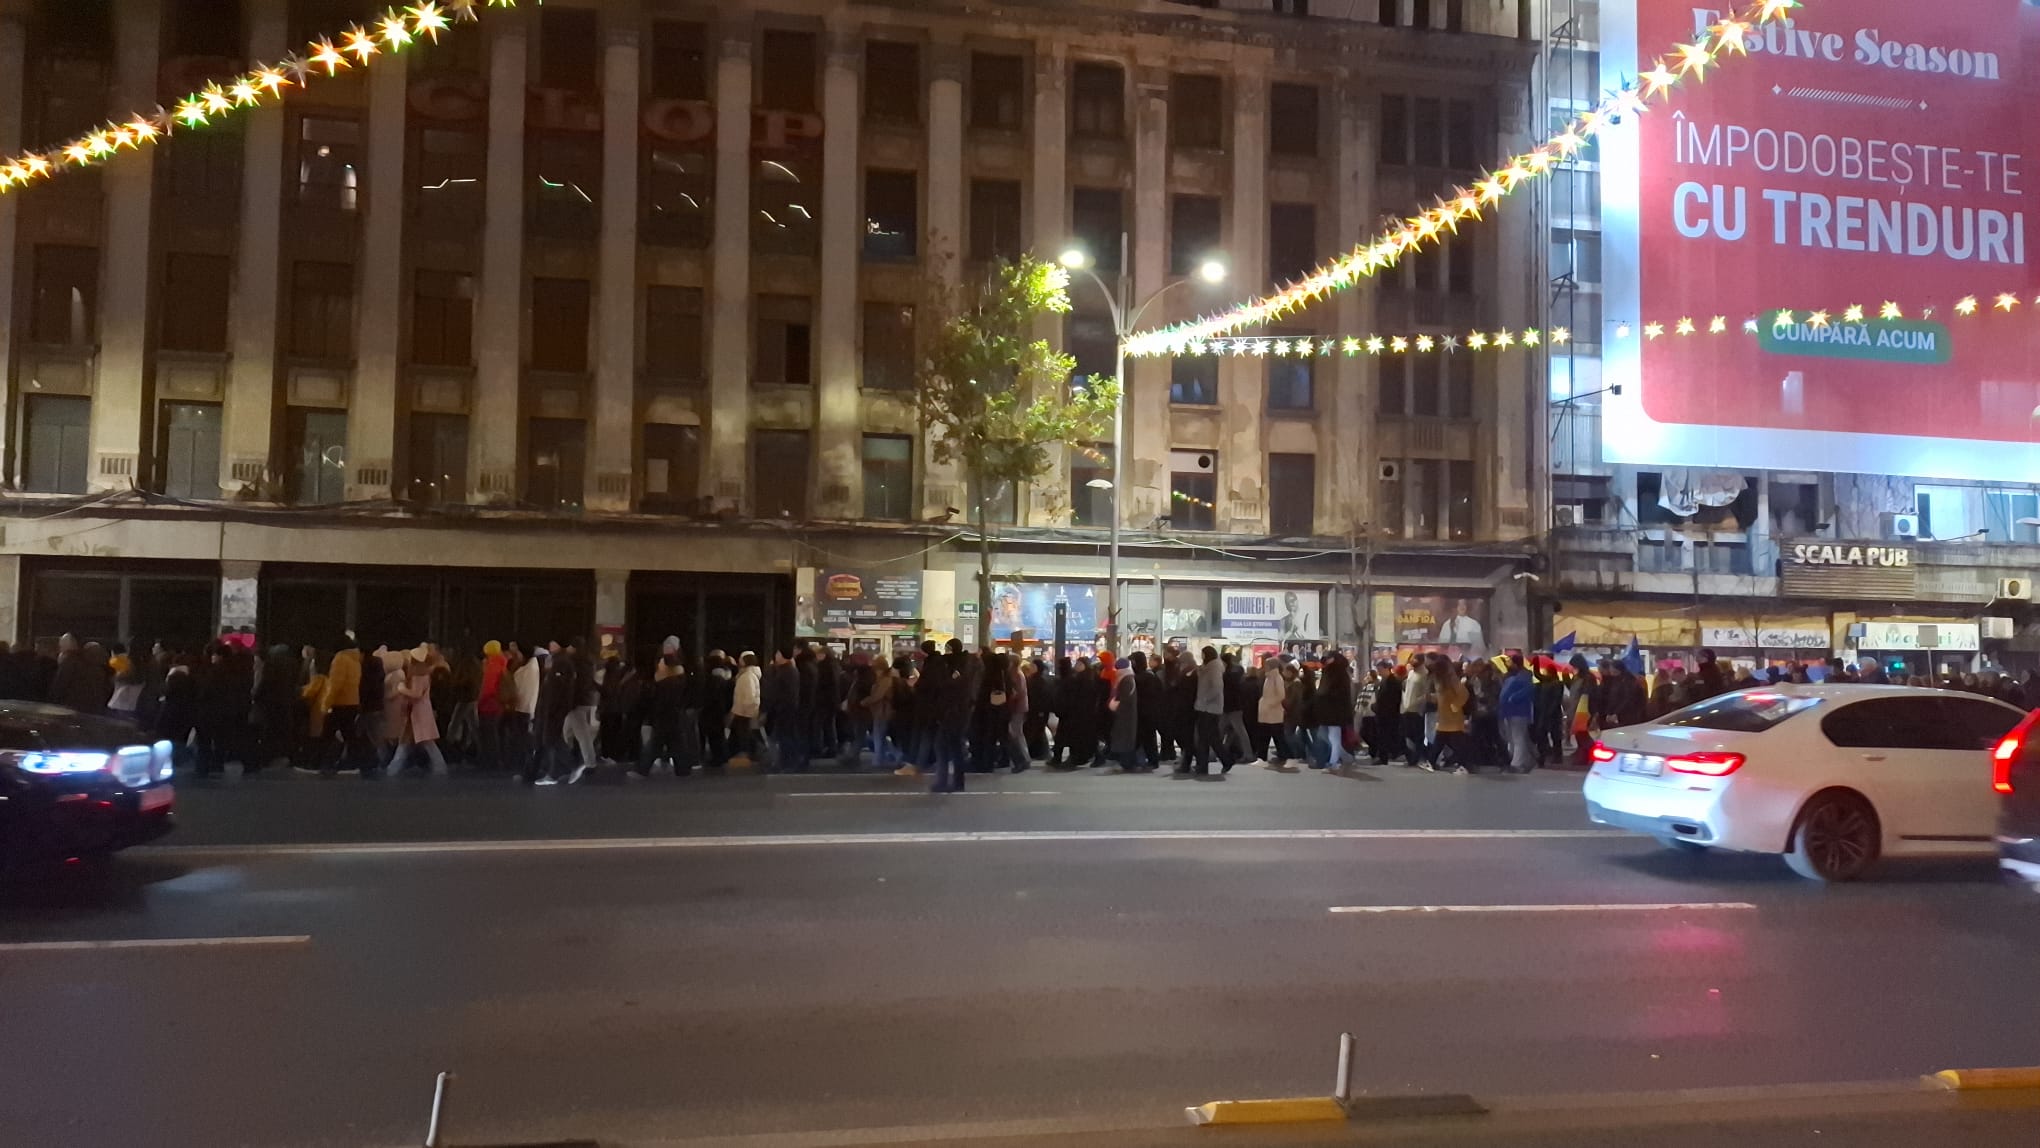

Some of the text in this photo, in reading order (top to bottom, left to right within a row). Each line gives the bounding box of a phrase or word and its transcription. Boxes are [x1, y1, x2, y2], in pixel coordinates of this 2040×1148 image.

[1692, 7, 1999, 80] Fstive Season
[1673, 181, 2025, 264] CU TRENDURI
[1772, 321, 1936, 350] CUMPĂRĂ ACUM
[1794, 544, 1909, 567] SCALA PUB
[1227, 596, 1275, 615] CONNECT-R
